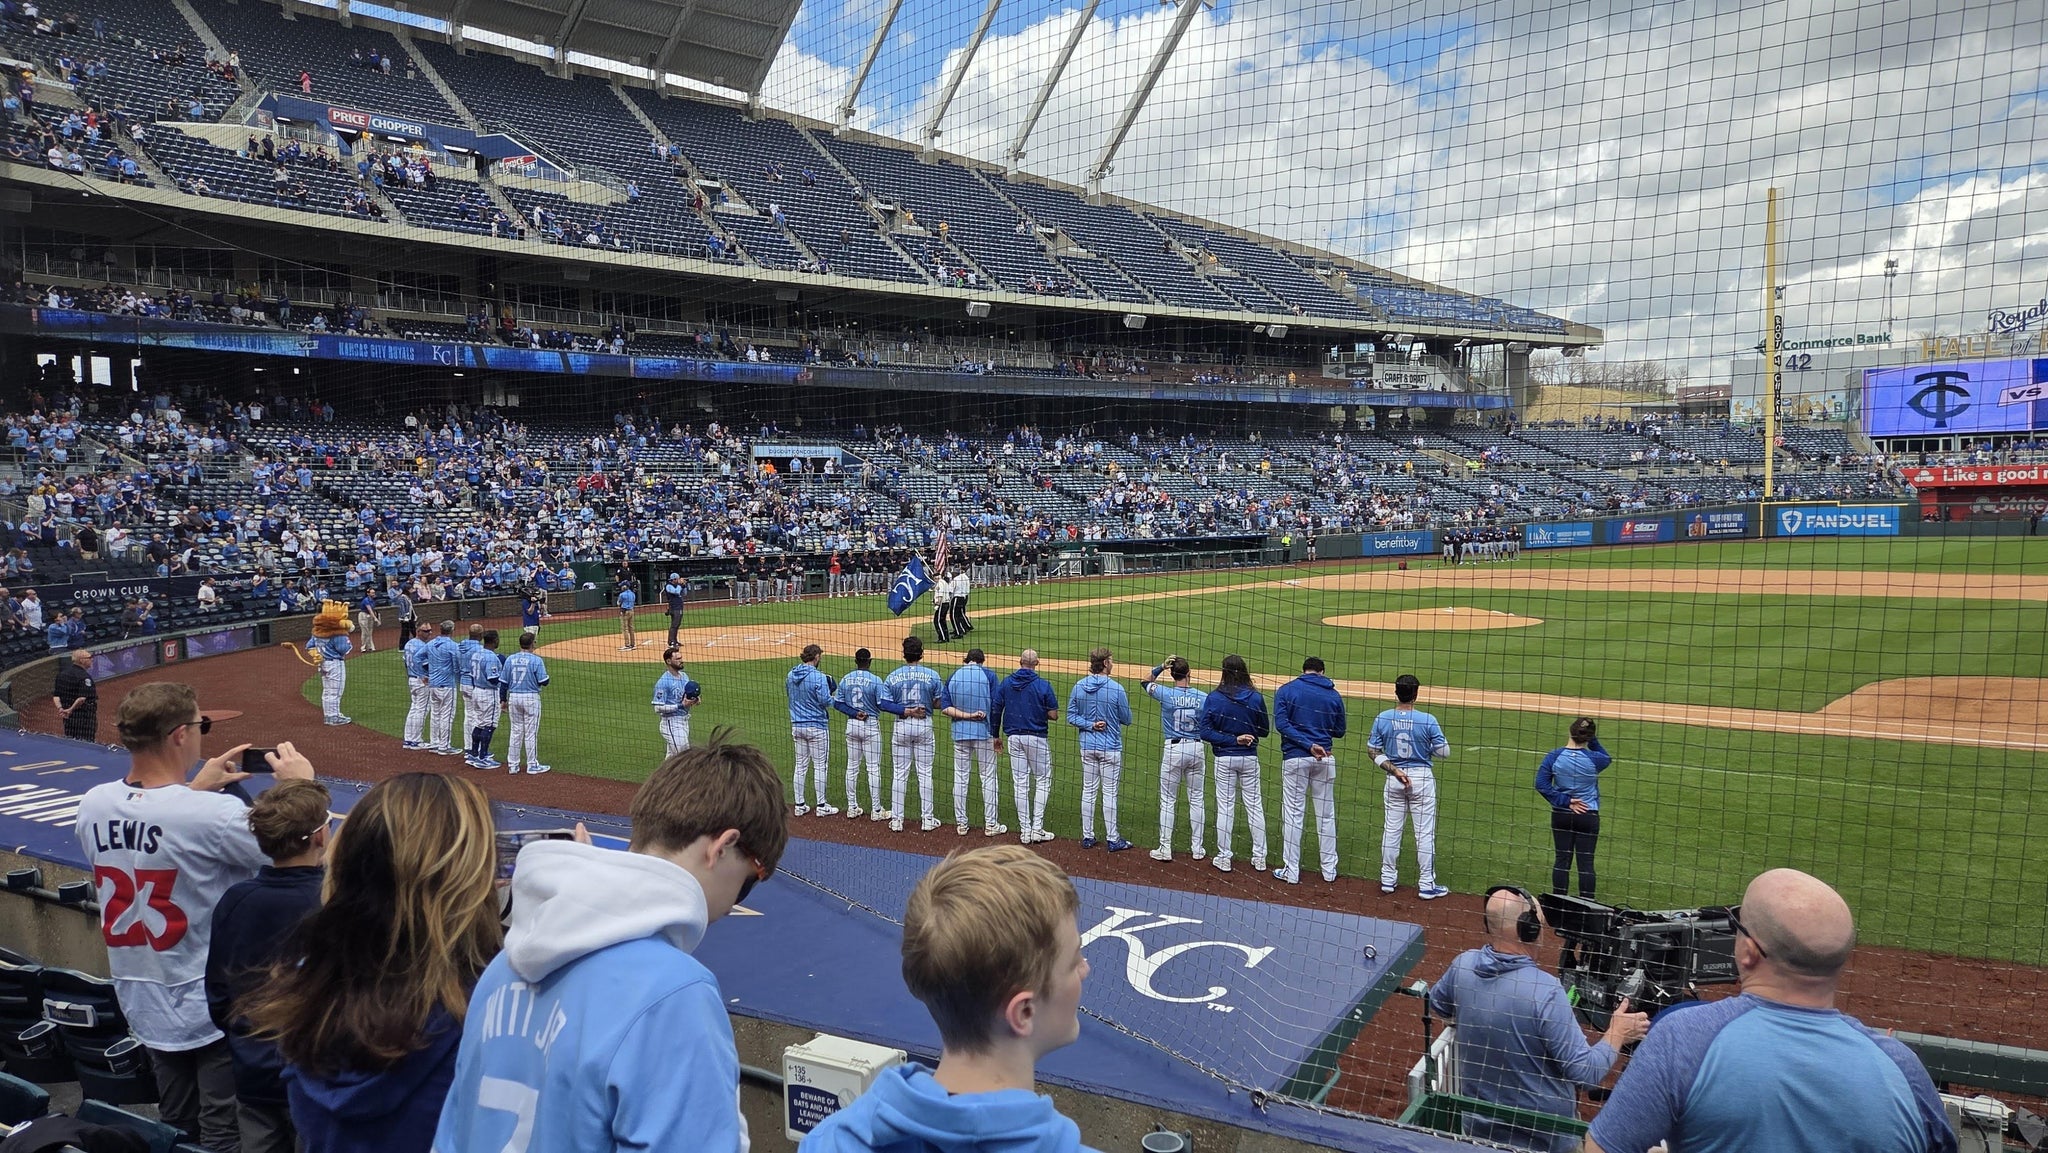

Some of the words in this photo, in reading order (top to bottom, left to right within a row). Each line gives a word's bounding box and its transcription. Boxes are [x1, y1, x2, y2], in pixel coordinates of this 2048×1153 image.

[333, 111, 365, 125] PRICE
[372, 118, 422, 136] CHOPPER
[1782, 336, 1853, 350] Commerce
[1857, 332, 1891, 344] Bank
[1921, 335, 2003, 358] HALL
[2009, 333, 2034, 358] of
[338, 342, 368, 357] KANSAS
[370, 344, 386, 359] CITY
[388, 345, 415, 361] ROYALS
[432, 345, 450, 366] KC
[1785, 353, 1812, 371] 42
[1384, 373, 1402, 383] CRAFT
[1409, 374, 1427, 384] DRAFT
[1943, 469, 1977, 482] Like
[1982, 472, 1992, 481] a
[1997, 467, 2038, 484] good
[1999, 496, 2045, 511] State
[1806, 514, 1892, 528] FANDUEL
[1375, 536, 1419, 551] benefitbay
[74, 588, 115, 599] CROWN
[120, 585, 149, 596] CLUB
[512, 667, 527, 684] 17
[852, 687, 864, 708] 2
[901, 683, 921, 704] 14
[1170, 696, 1200, 709] THOMAS
[1173, 709, 1196, 731] 15
[1396, 732, 1413, 759] 6
[9, 760, 99, 775] OF
[93, 820, 162, 854] LEWIS
[94, 865, 188, 952] 23
[1080, 906, 1276, 1003] KC
[482, 981, 541, 1043] WITT
[534, 999, 567, 1060] JR
[794, 1065, 806, 1075] 135
[795, 1074, 806, 1083] 136
[793, 1099, 809, 1109] BATS
[809, 1104, 823, 1112] AND
[800, 1091, 826, 1103] BEWARE
[826, 1098, 835, 1106] OF
[478, 1075, 539, 1153] 7
